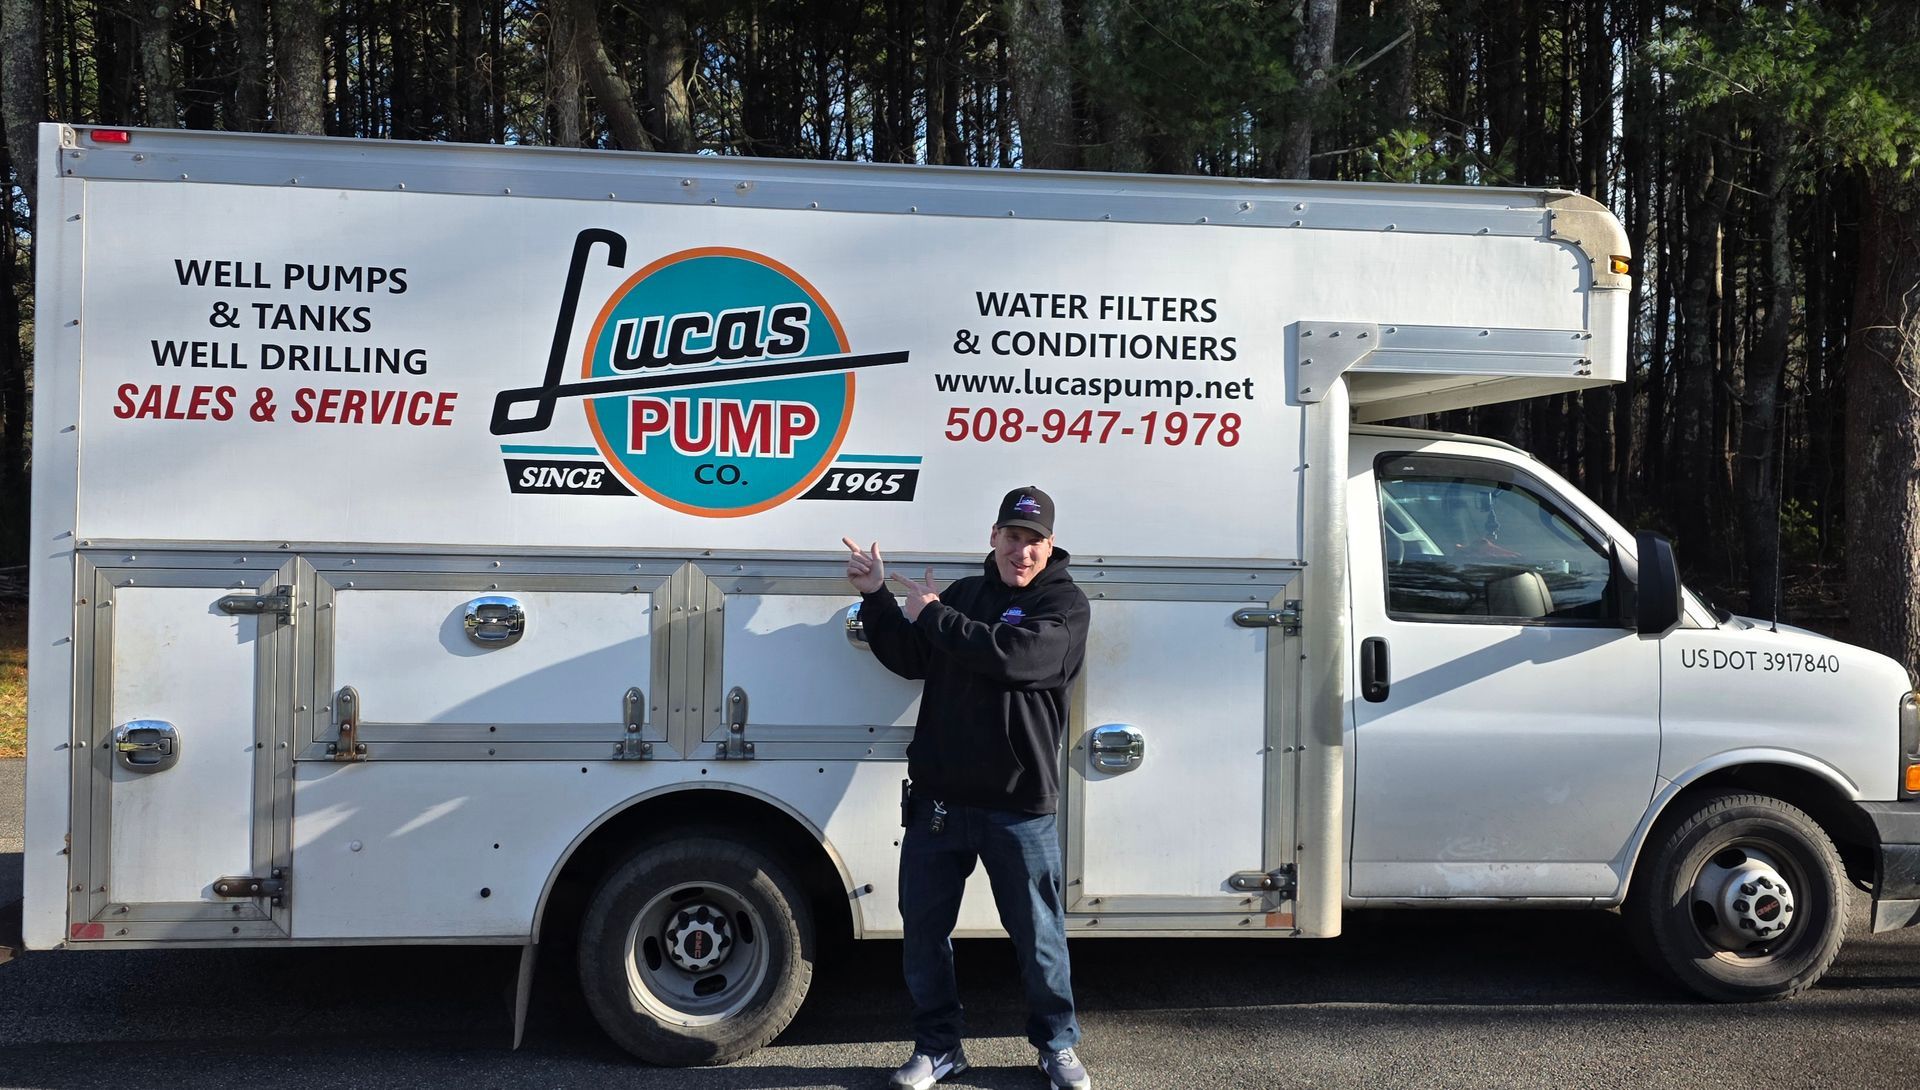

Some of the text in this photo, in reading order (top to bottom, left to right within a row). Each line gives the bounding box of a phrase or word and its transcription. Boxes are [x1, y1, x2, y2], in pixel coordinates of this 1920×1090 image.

[174, 259, 407, 294] WELL PUMPS
[209, 301, 371, 332] & TANKS
[975, 291, 1217, 323] WATER FILTERS
[489, 227, 910, 436] Lucas
[953, 329, 1237, 362] & CONDITIONERS
[151, 340, 427, 375] WELL DRILLING
[934, 368, 1255, 406] www.lucaspump.net
[113, 383, 458, 426] SALES & SERVICE
[627, 396, 819, 459] PUMP
[945, 407, 1242, 447] 508-947-1978
[519, 466, 605, 489] SINCE
[694, 463, 748, 487] CO.
[826, 471, 905, 494] 1965
[1763, 652, 1840, 673] 3917840
